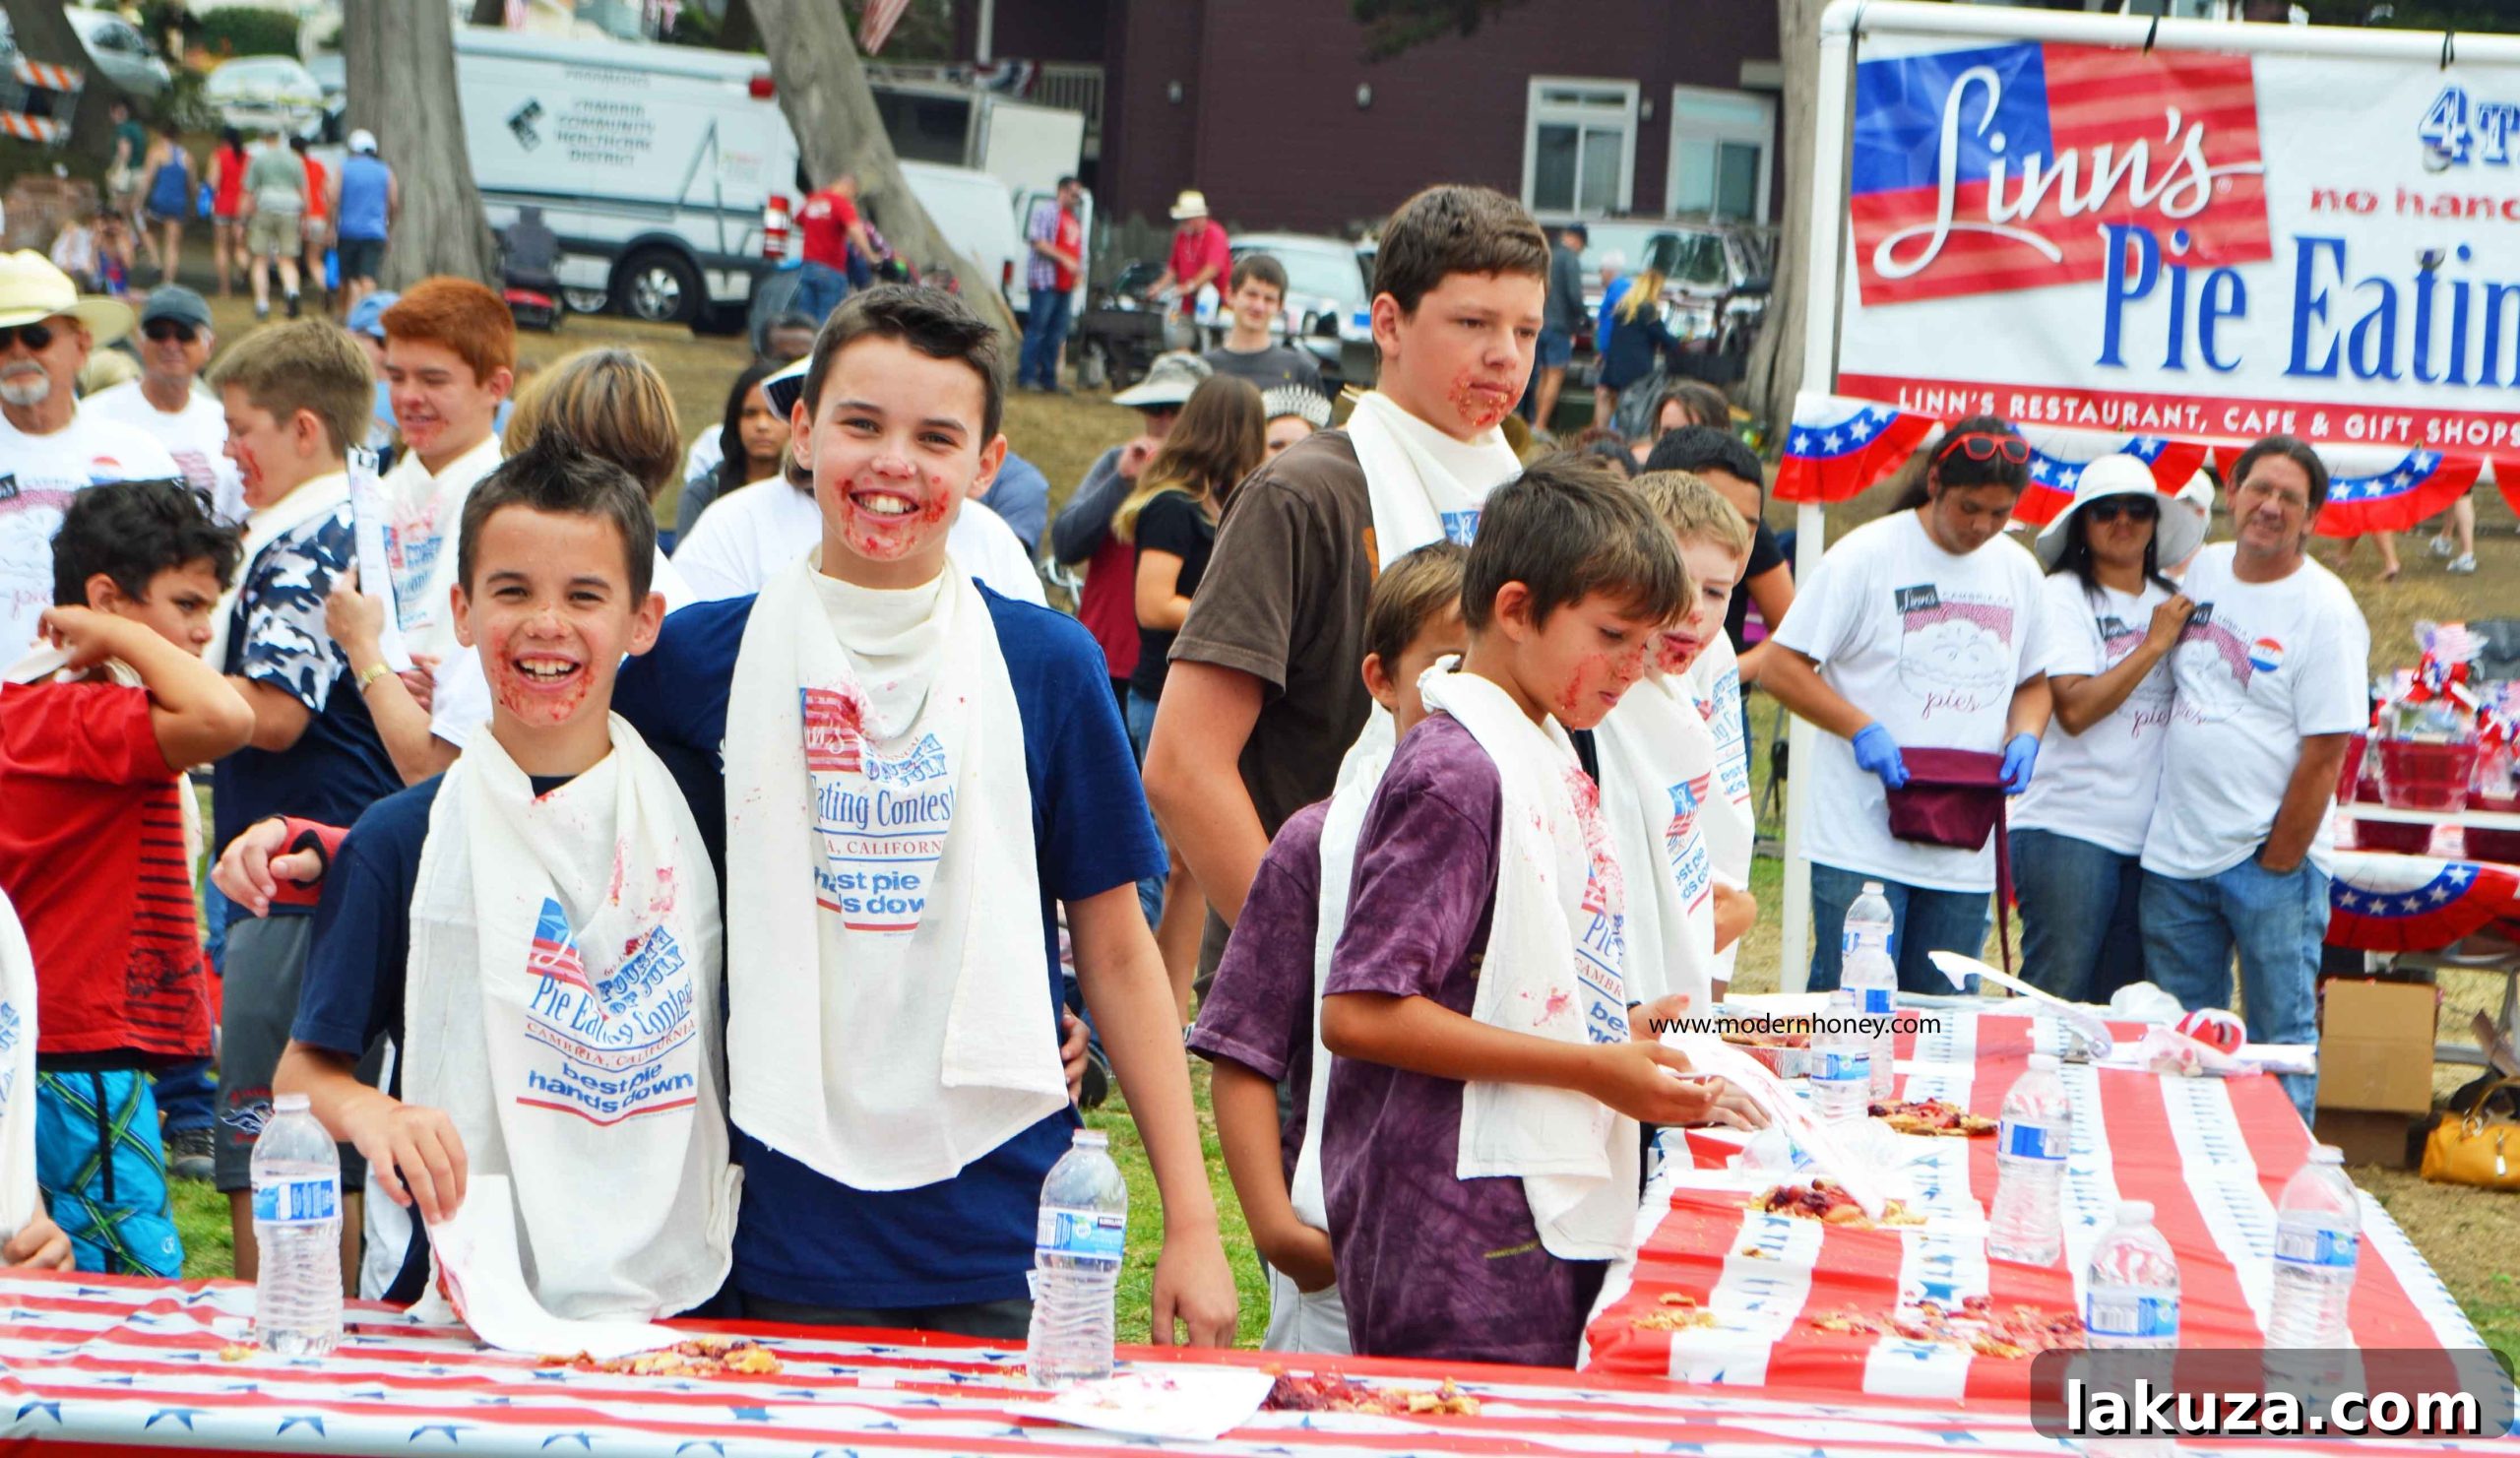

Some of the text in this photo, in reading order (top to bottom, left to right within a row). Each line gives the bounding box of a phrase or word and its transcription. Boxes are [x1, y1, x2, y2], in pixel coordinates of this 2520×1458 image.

[1873, 65, 2264, 279] Linn's
[2310, 188, 2378, 213] no
[2095, 222, 2249, 372] Pie
[1899, 387, 1994, 416] LINN'S
[2009, 395, 2208, 434] RESTAURANT,
[2223, 405, 2297, 434] CAFE
[2309, 412, 2329, 436] &
[2345, 413, 2413, 441] GIFT
[1922, 689, 1981, 720] pies
[847, 841, 943, 855] CALIFORN
[872, 870, 921, 894] pie
[866, 895, 925, 915] dow
[530, 974, 571, 1021] Pie
[529, 1070, 694, 1112] hands down
[562, 1062, 662, 1095] best pie
